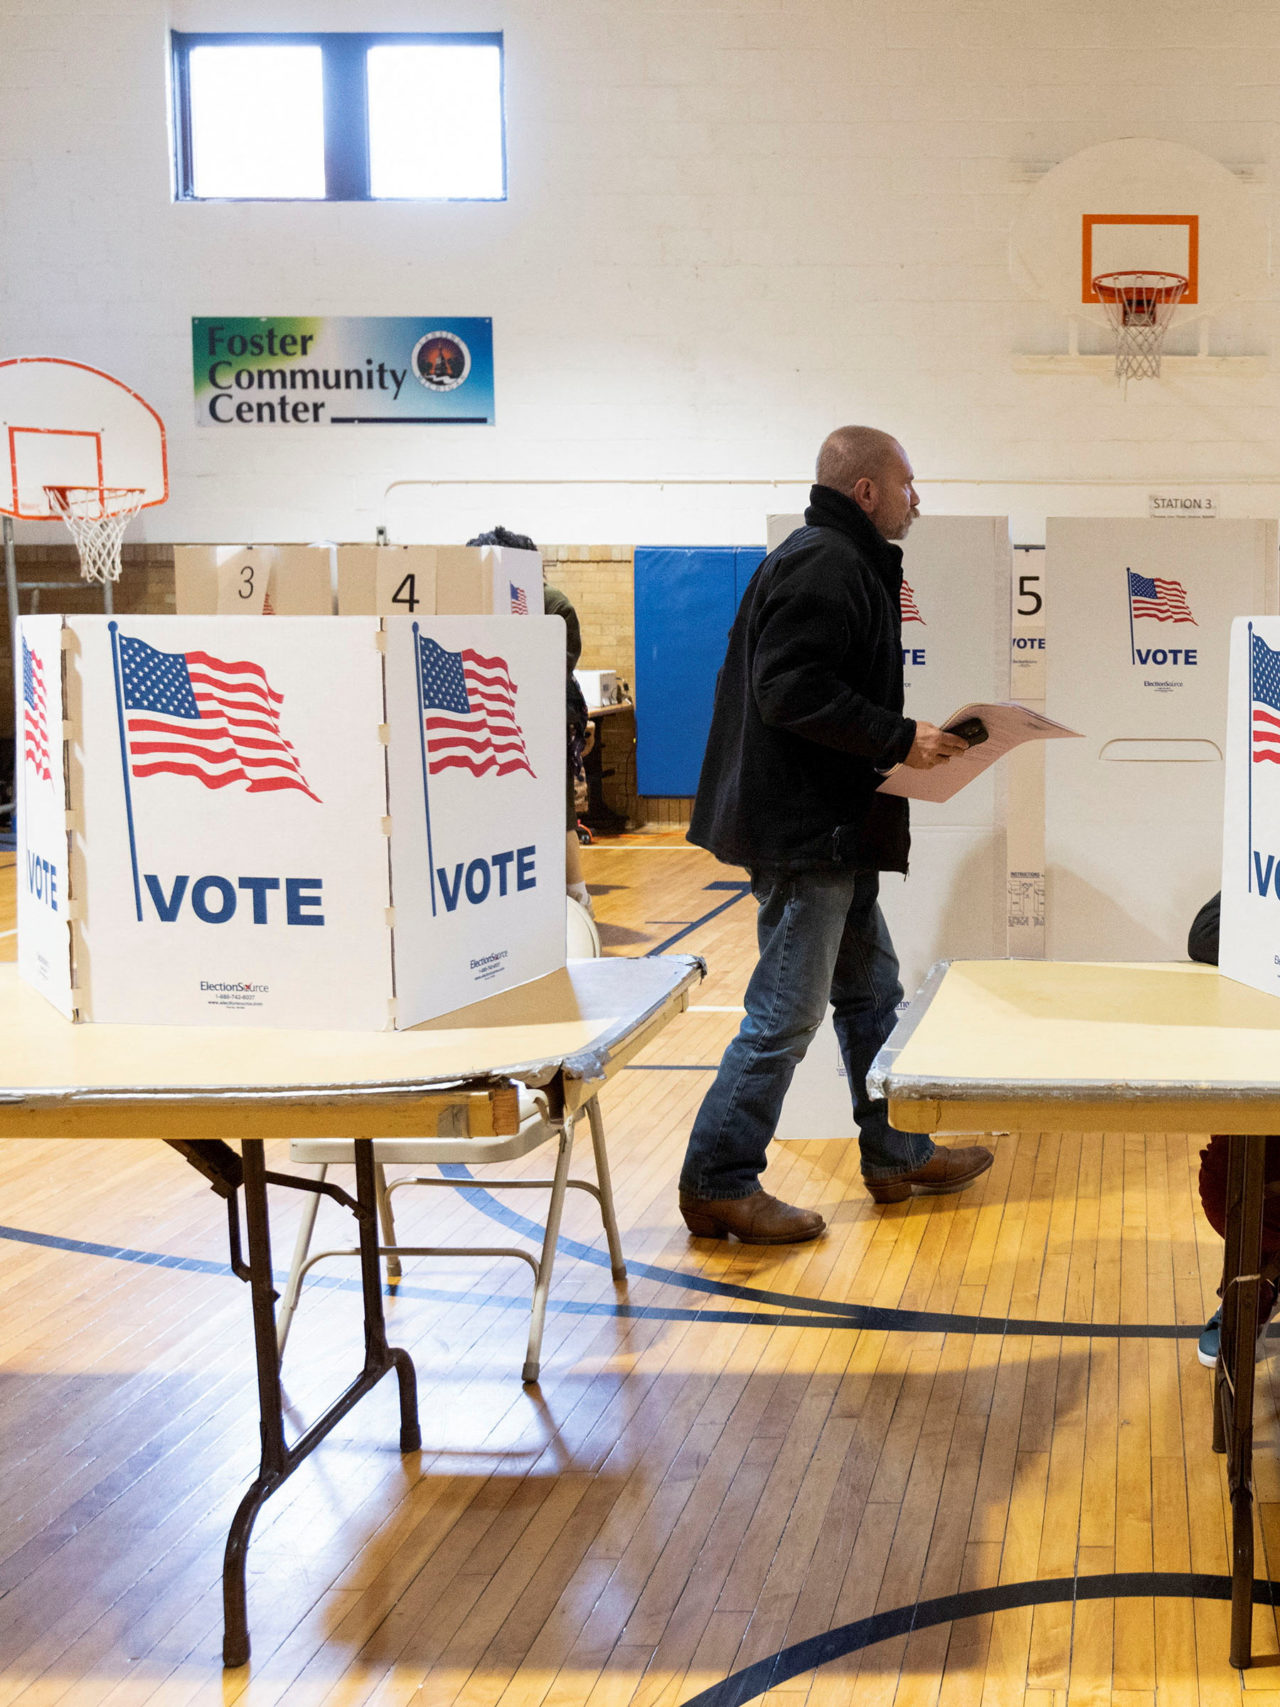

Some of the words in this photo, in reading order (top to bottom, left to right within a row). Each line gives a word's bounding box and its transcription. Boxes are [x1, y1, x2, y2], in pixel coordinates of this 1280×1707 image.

[208, 325, 314, 357] Foster
[208, 358, 407, 400] Community
[209, 393, 325, 423] Center
[1153, 498, 1202, 509] STATION
[1205, 498, 1212, 509] 3
[238, 566, 255, 599] 3
[392, 573, 420, 613] 4
[1017, 576, 1042, 616] 5
[1012, 638, 1046, 649] OTE
[1136, 649, 1198, 665] VOTE
[28, 850, 58, 911] VOTE
[436, 845, 537, 912] VOTE
[144, 874, 325, 926] VOTE
[200, 981, 269, 993] ElectionSource
